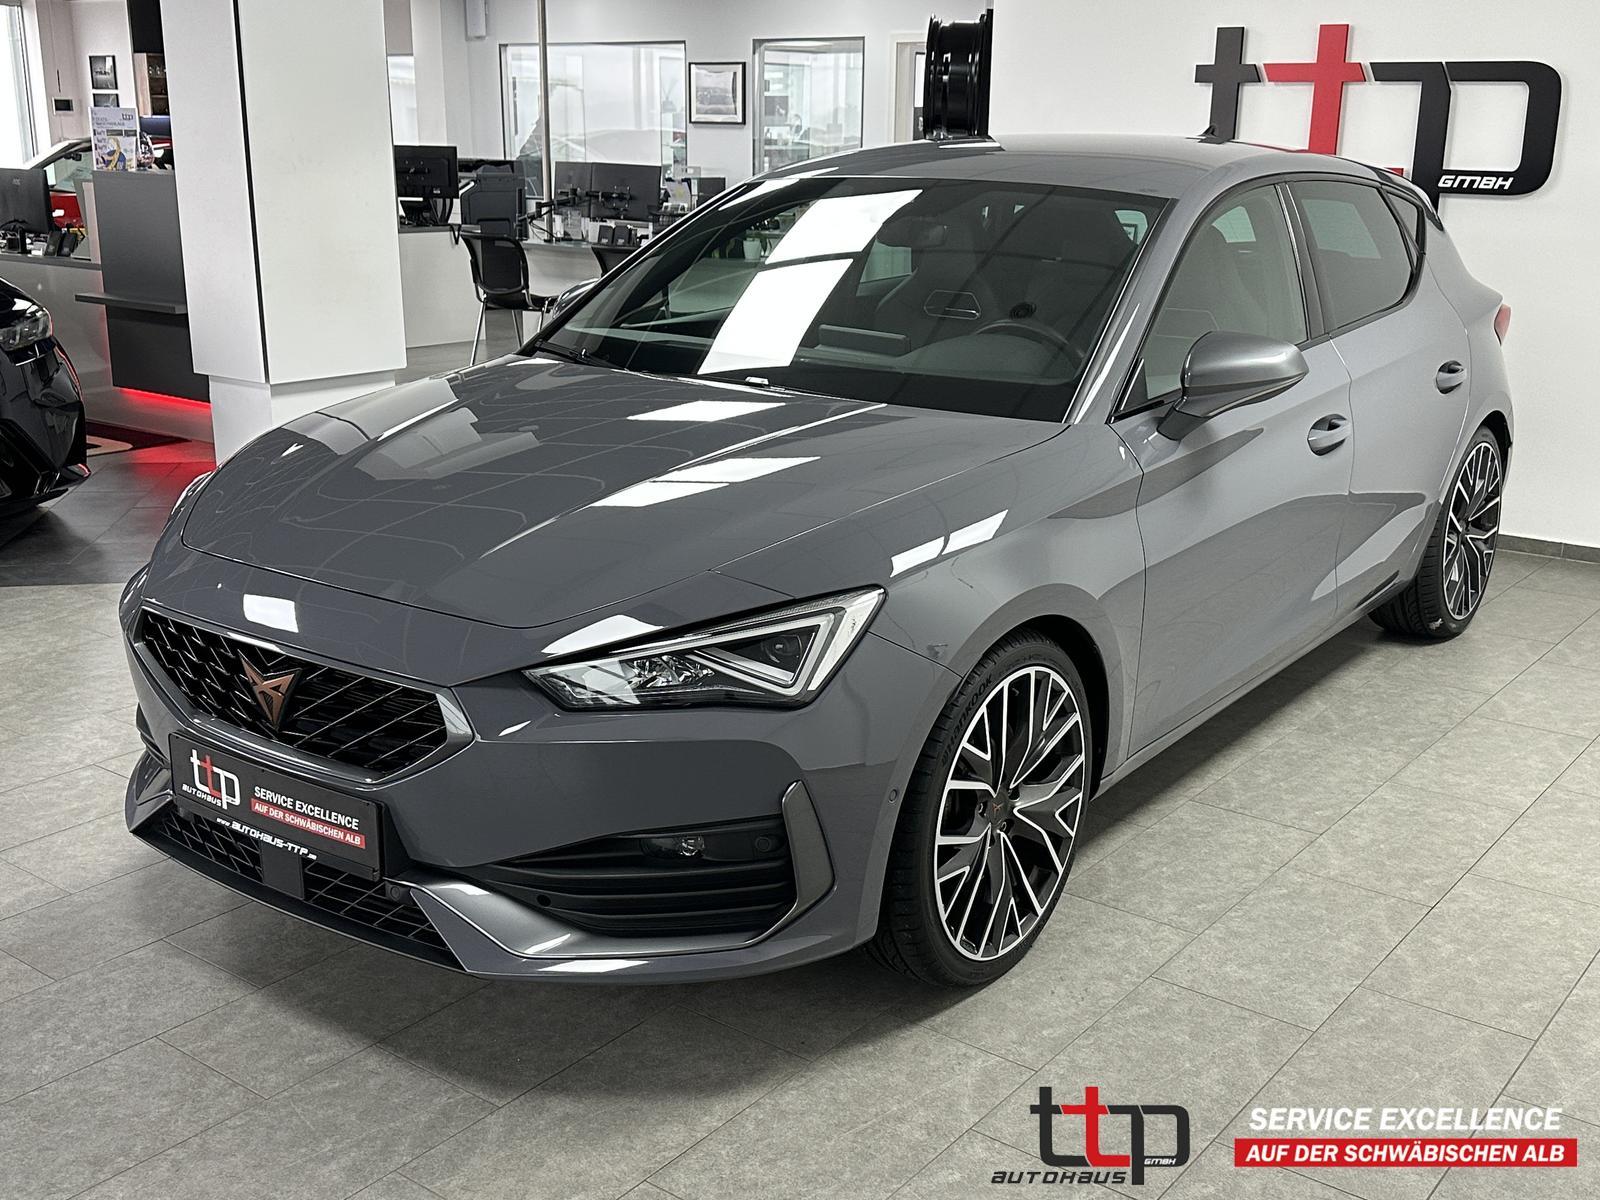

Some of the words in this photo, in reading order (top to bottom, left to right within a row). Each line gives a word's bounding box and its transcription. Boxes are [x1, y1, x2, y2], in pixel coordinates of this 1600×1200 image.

[1438, 175, 1514, 190] GMBH
[182, 783, 222, 807] AUTOHAUS
[190, 749, 240, 810] ttp
[254, 786, 294, 809] SERVICE
[295, 799, 360, 830] EXCELLENCE
[254, 802, 269, 813] AUF
[268, 807, 284, 818] DER
[284, 811, 344, 840] SCHWÄBISCHEN
[345, 833, 361, 845] ALB
